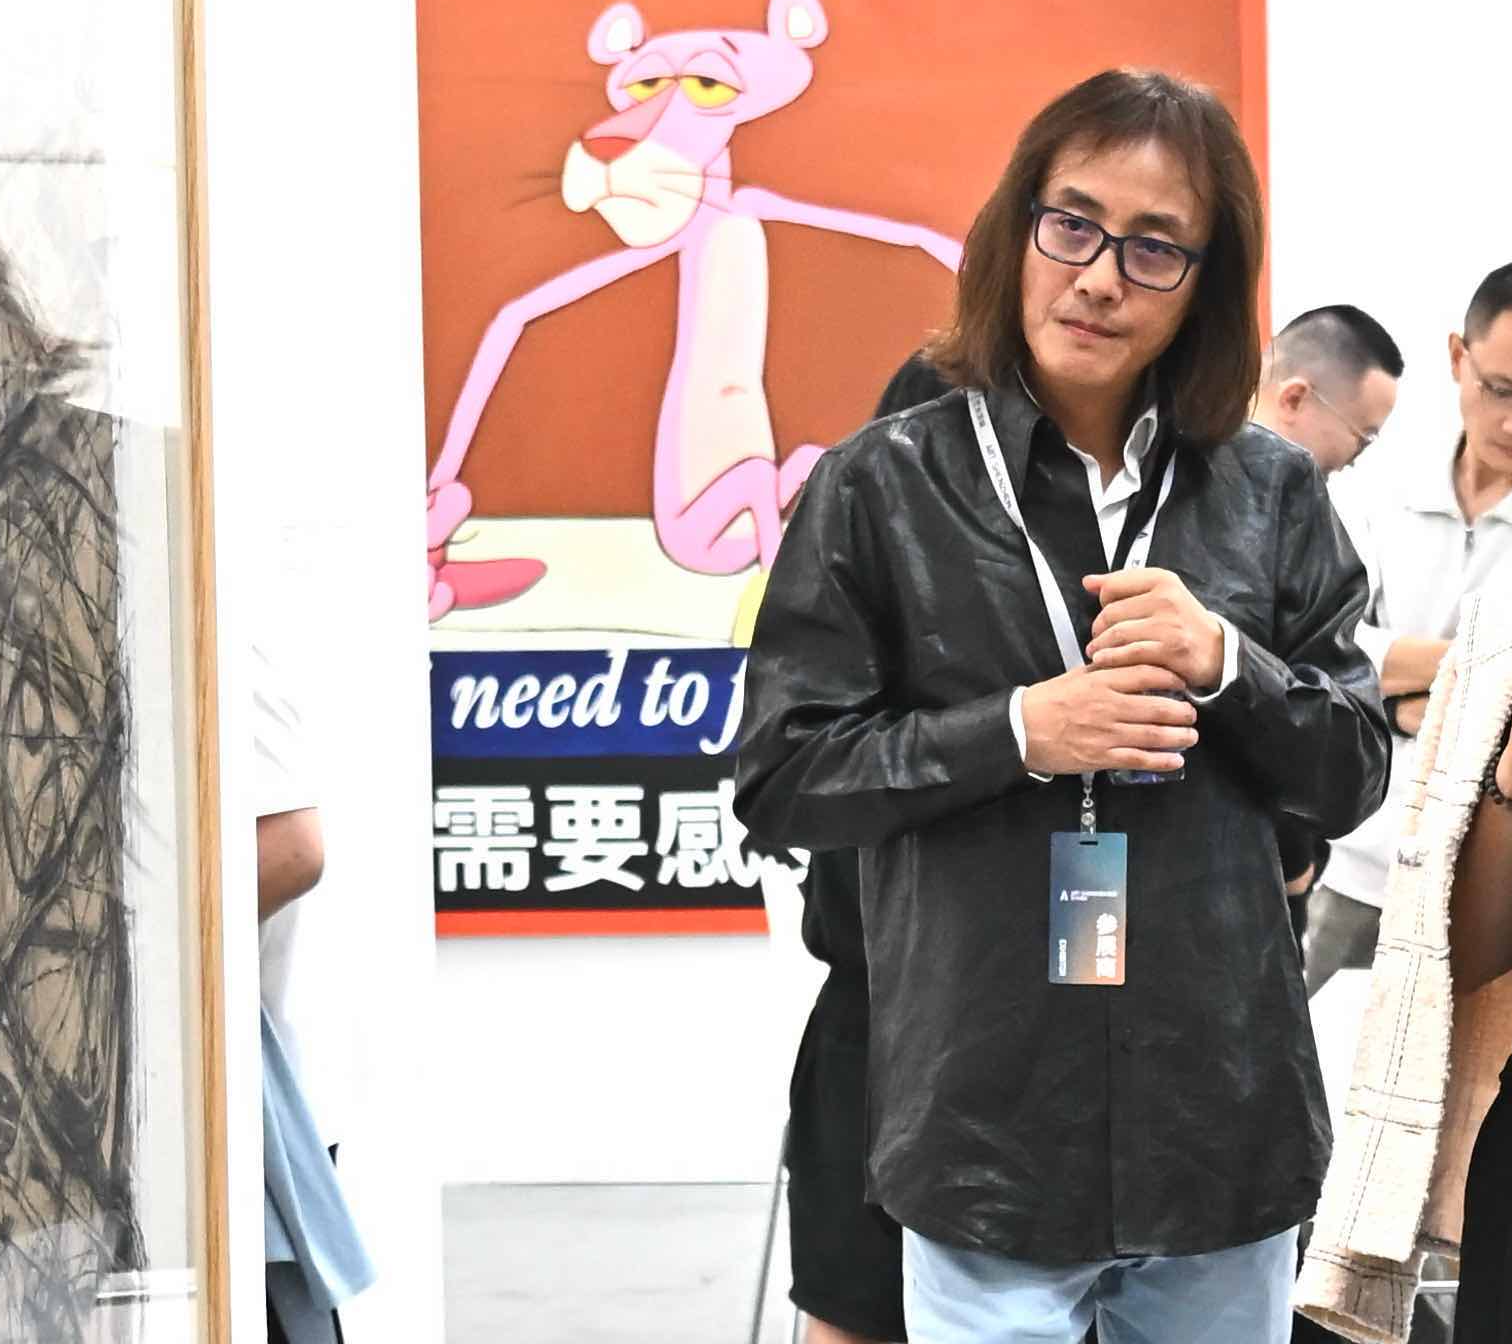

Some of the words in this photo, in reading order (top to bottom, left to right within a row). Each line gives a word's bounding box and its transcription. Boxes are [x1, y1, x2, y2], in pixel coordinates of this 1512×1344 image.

[450, 649, 630, 729] need
[638, 657, 711, 729] to
[434, 778, 761, 892] 需要感
